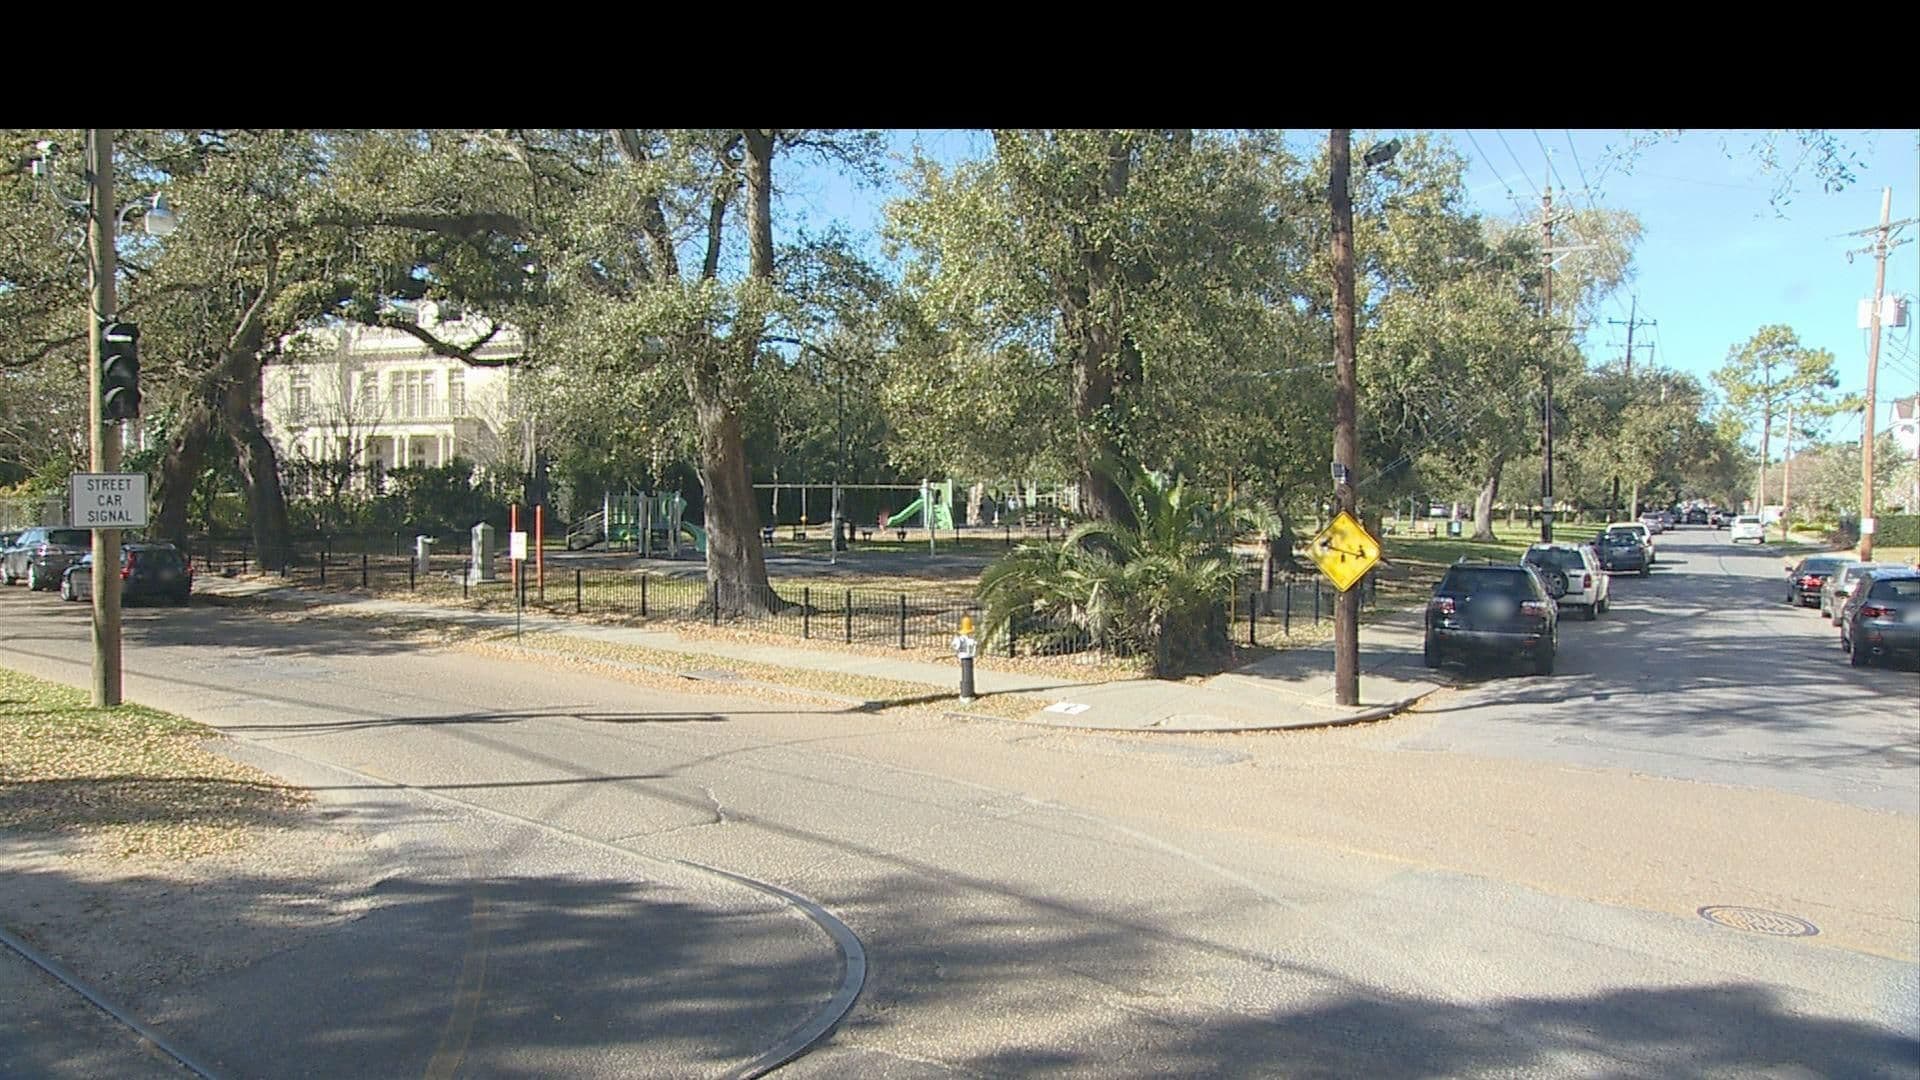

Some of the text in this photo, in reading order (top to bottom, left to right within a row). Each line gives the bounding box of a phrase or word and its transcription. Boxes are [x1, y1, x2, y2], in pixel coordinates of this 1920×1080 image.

[87, 479, 132, 491] STREET
[97, 494, 122, 506] CAR
[87, 510, 132, 522] SIGNAL
